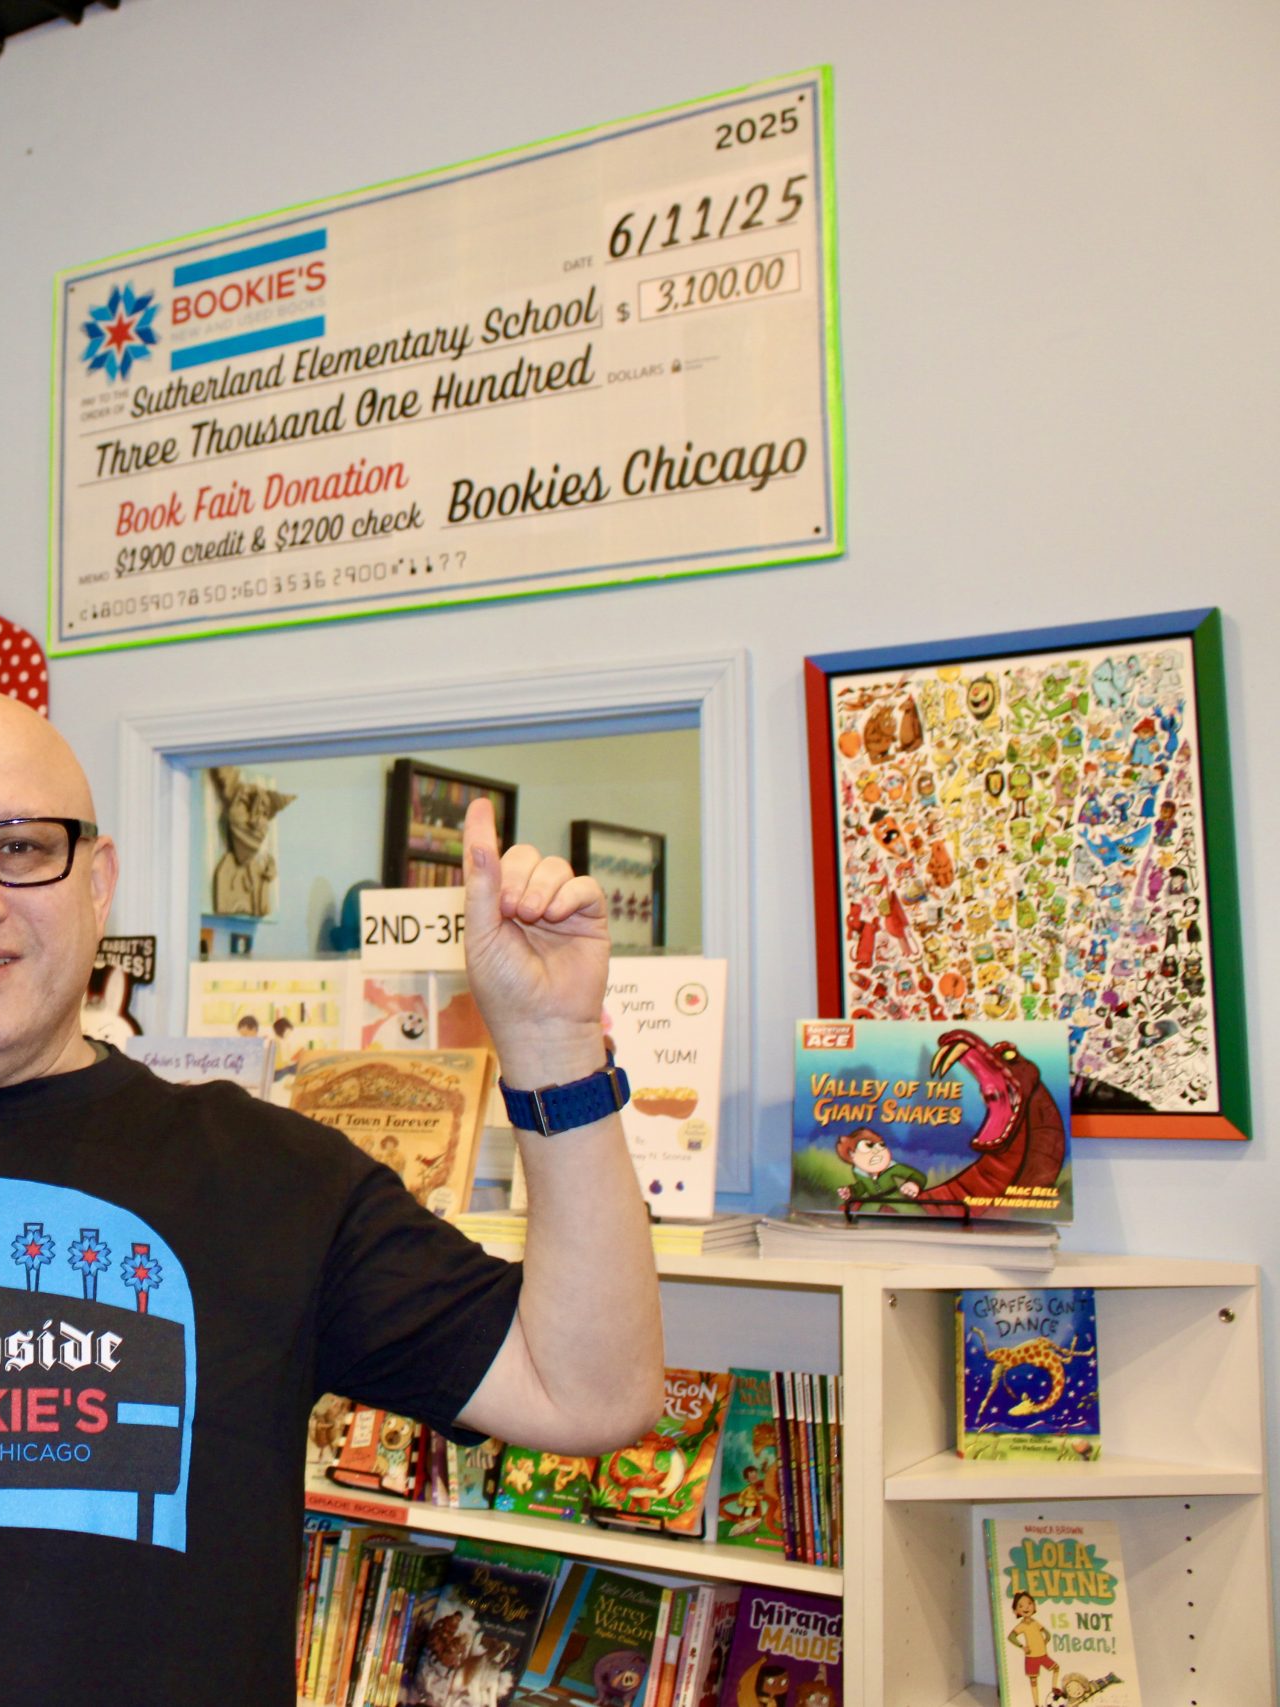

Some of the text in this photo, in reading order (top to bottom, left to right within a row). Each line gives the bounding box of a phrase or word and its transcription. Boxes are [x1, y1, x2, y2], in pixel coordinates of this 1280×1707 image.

[715, 107, 799, 151] 2025
[563, 174, 808, 273] DATE 6/11/25
[172, 261, 326, 326] BOOKIE'S
[238, 307, 273, 325] USED
[277, 296, 327, 316] BOOKS
[617, 302, 630, 323] $
[130, 285, 600, 418] Sutherland Elementary School
[608, 362, 664, 385] DOLLARS
[96, 343, 595, 478] Three Thousand One Hundred
[447, 437, 807, 523] Bookies Chicago
[115, 458, 410, 536] Book Fair Donation
[115, 503, 423, 579] $1900 credit & $1200 check
[607, 984, 638, 997] yum
[622, 1000, 655, 1015] yum
[637, 1019, 671, 1034] yum
[806, 1034, 850, 1048] ACE
[654, 1049, 697, 1064] YUM!
[810, 1072, 964, 1102] VALLEY OF THE
[345, 1113, 381, 1126] Town
[385, 1115, 440, 1128] Forever
[813, 1097, 963, 1127] GIANT SNAKES
[973, 1295, 1043, 1318] GIRAFFES
[995, 1317, 1060, 1338] DANCE
[1024, 1540, 1093, 1569] LOLA
[1011, 1568, 1114, 1598] LEVINE
[751, 1598, 843, 1637] Mirand
[1050, 1612, 1113, 1631] IS NOT
[759, 1626, 840, 1663] MAUDE
[1052, 1634, 1117, 1655] Mean!
